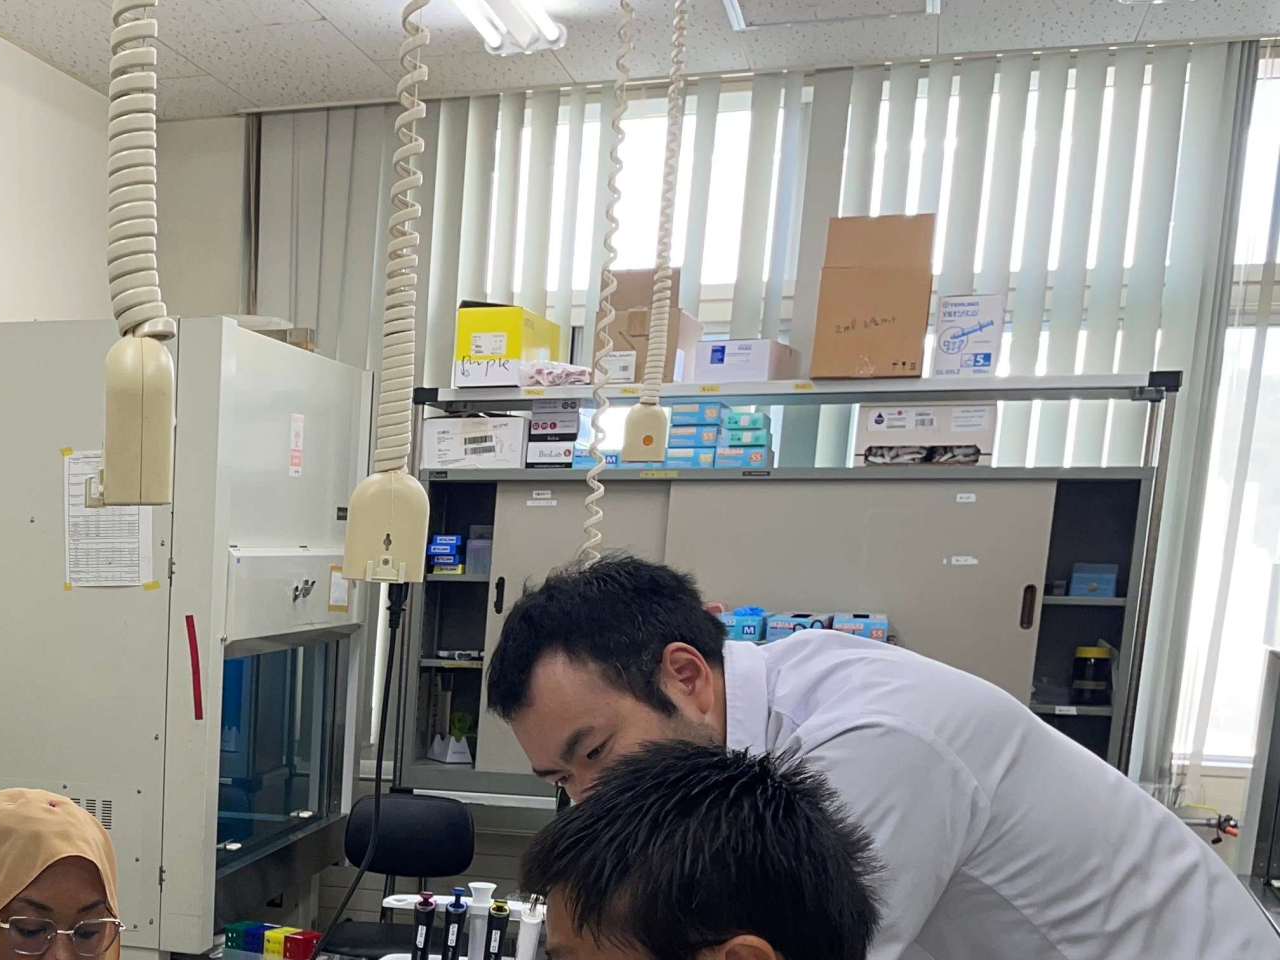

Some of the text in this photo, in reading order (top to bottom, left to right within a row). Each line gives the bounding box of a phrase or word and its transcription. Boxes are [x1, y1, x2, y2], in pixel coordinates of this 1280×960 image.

[538, 449, 563, 458] BioLab
[750, 453, 762, 462] SS
[606, 455, 617, 464] M
[744, 626, 754, 634] M
[871, 630, 884, 638] SS
